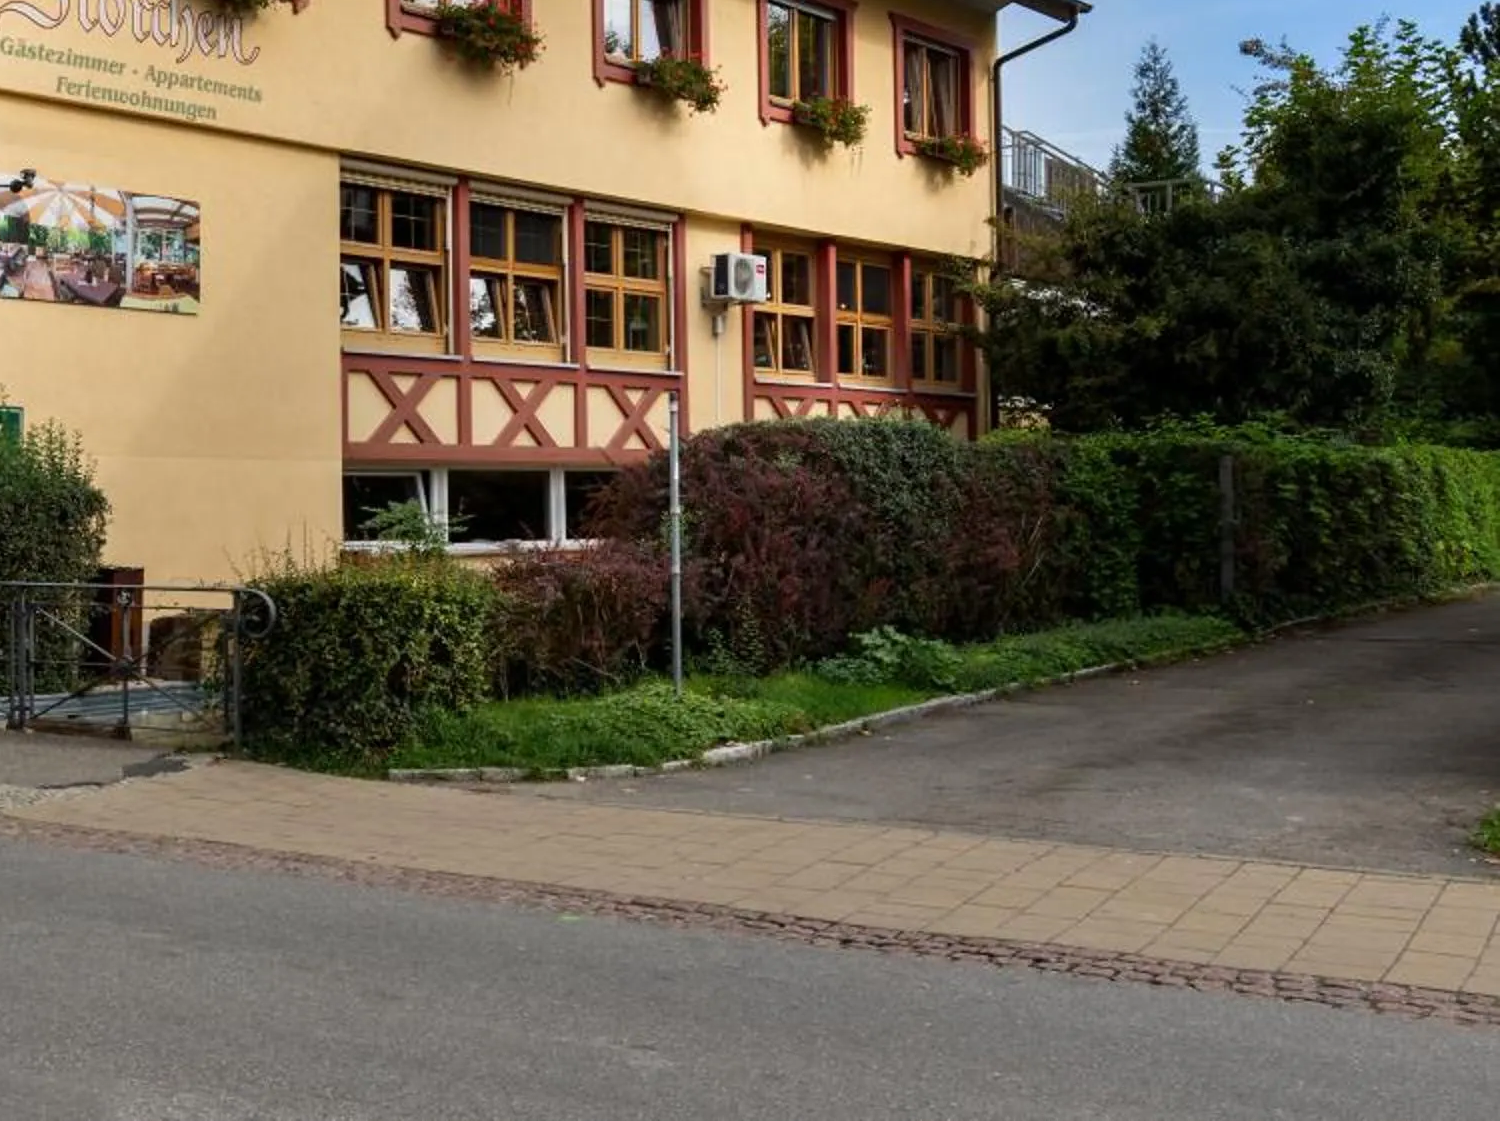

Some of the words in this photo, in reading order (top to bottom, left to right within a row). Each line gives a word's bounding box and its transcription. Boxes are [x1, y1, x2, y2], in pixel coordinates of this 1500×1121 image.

[0, 36, 127, 76] Gästezimmer
[144, 64, 264, 103] Appartements
[56, 75, 218, 121] Ferienwohnungen
